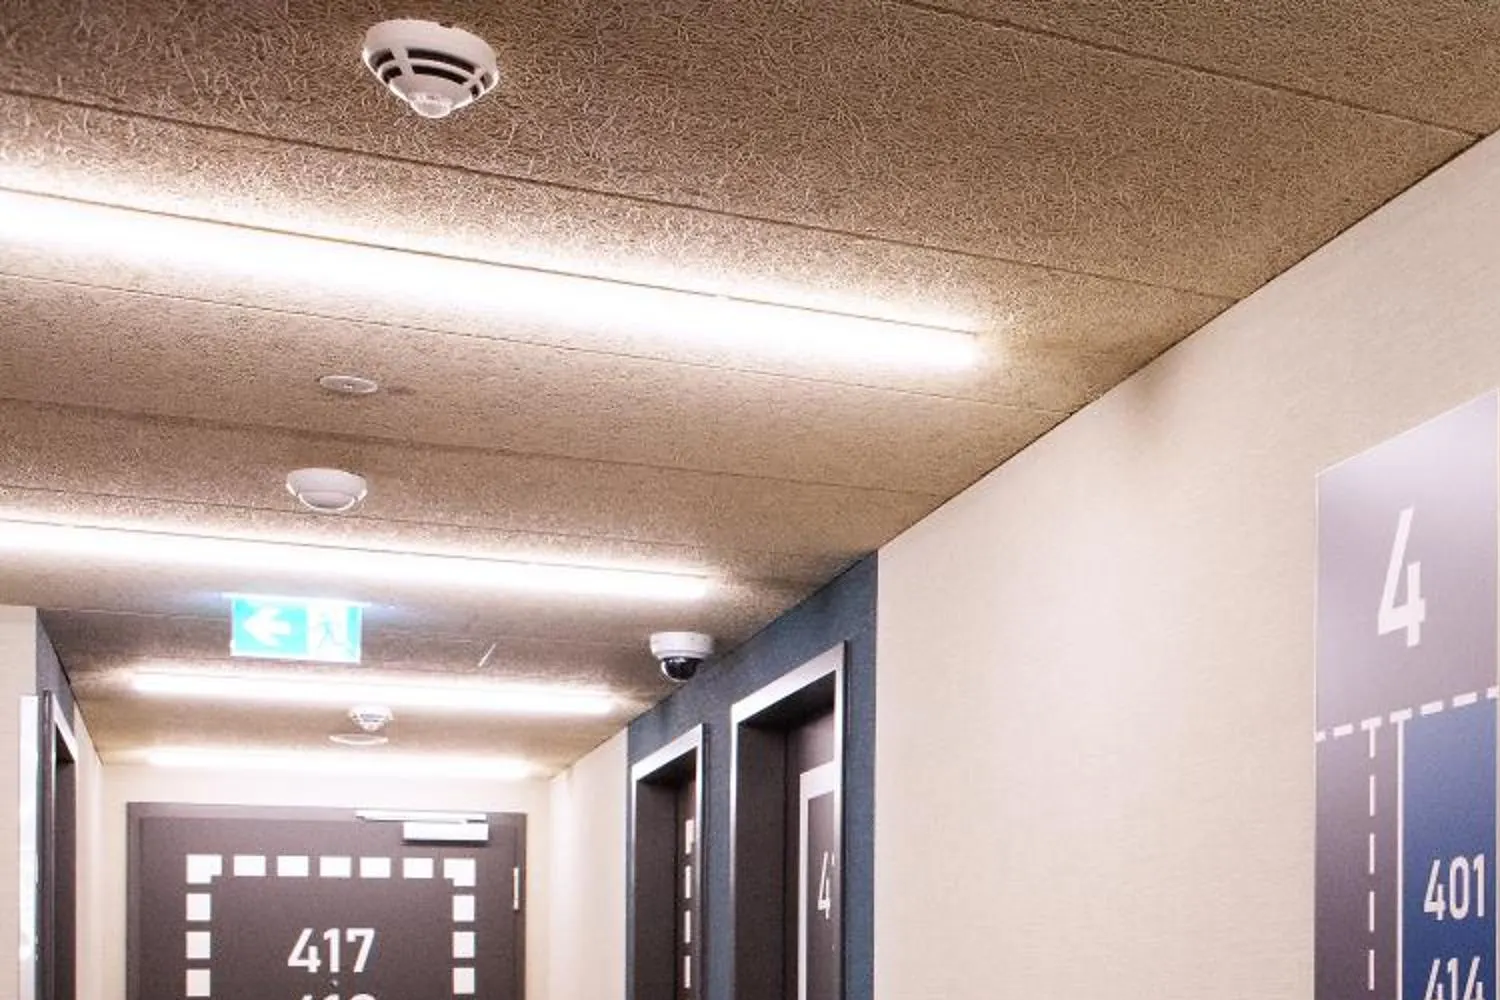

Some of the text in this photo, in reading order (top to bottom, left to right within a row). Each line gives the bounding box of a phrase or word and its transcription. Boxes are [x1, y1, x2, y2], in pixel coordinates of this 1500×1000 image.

[1376, 505, 1426, 647] 4
[1423, 854, 1485, 921] 401
[288, 927, 376, 973] 417
